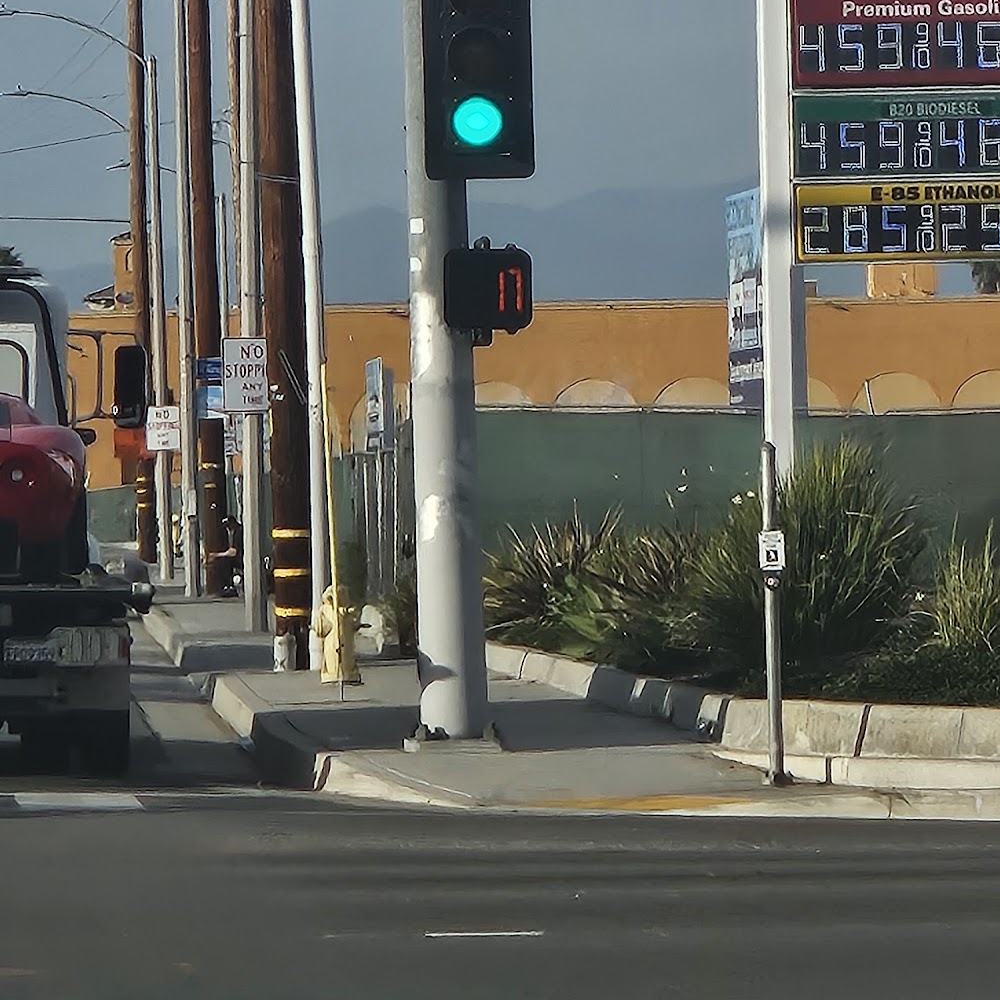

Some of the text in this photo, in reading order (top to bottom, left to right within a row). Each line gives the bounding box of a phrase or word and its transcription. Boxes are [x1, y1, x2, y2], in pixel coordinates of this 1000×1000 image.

[842, 1, 930, 18] Premium
[889, 101, 981, 117] B20 BIODIESEL
[871, 187, 920, 201] E-85
[240, 345, 263, 359] NO
